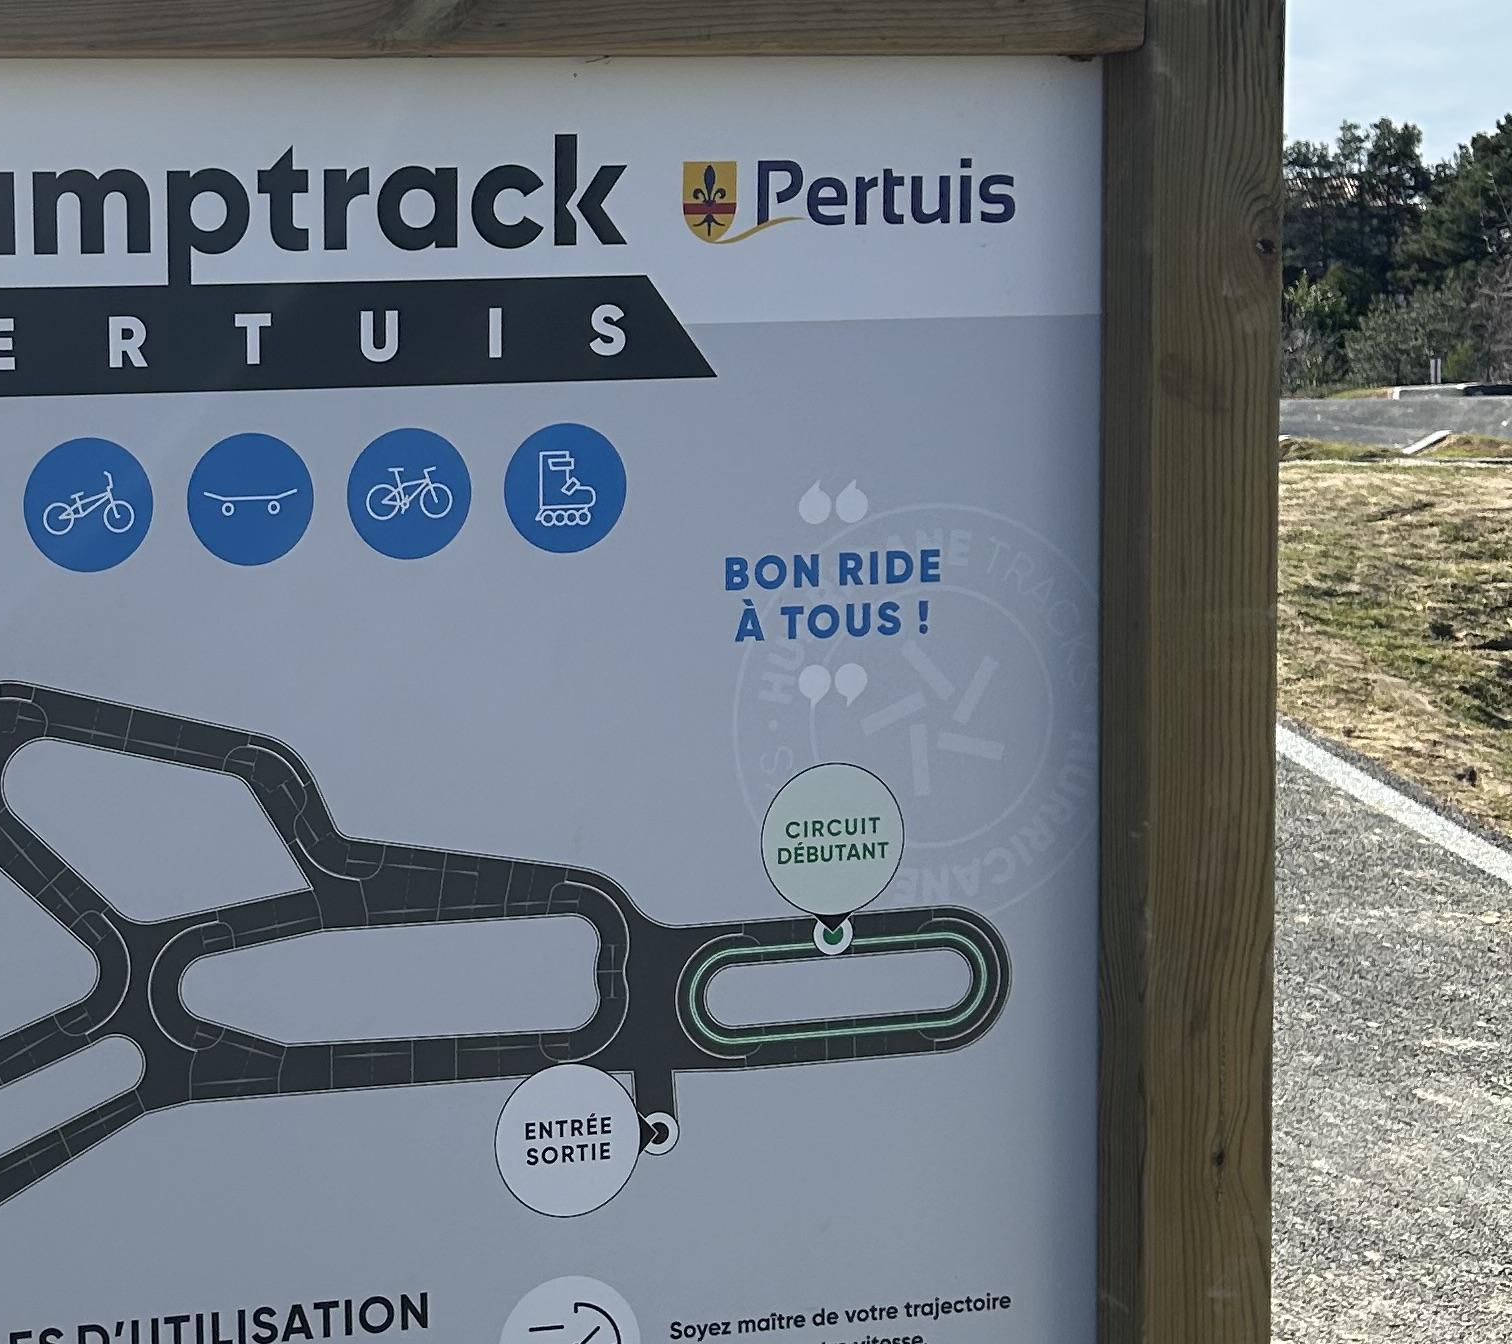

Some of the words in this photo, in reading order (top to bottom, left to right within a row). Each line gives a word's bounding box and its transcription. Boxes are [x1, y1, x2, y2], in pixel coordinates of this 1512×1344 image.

[757, 158, 1016, 227] Pertuis
[725, 554, 819, 591] BON
[839, 549, 940, 586] RIDE
[735, 599, 765, 642] À
[780, 601, 901, 640] TOUS
[785, 817, 880, 839] CIRCUIT
[778, 842, 889, 865] DÉBUTANT
[525, 1113, 611, 1140] ENTRÉE
[526, 1142, 610, 1166] SORTIE
[670, 1321, 731, 1342] Soyez
[738, 1312, 806, 1334] maître
[812, 1308, 839, 1326] de
[845, 1305, 898, 1323] votre
[904, 1293, 1011, 1320] trajectoire
